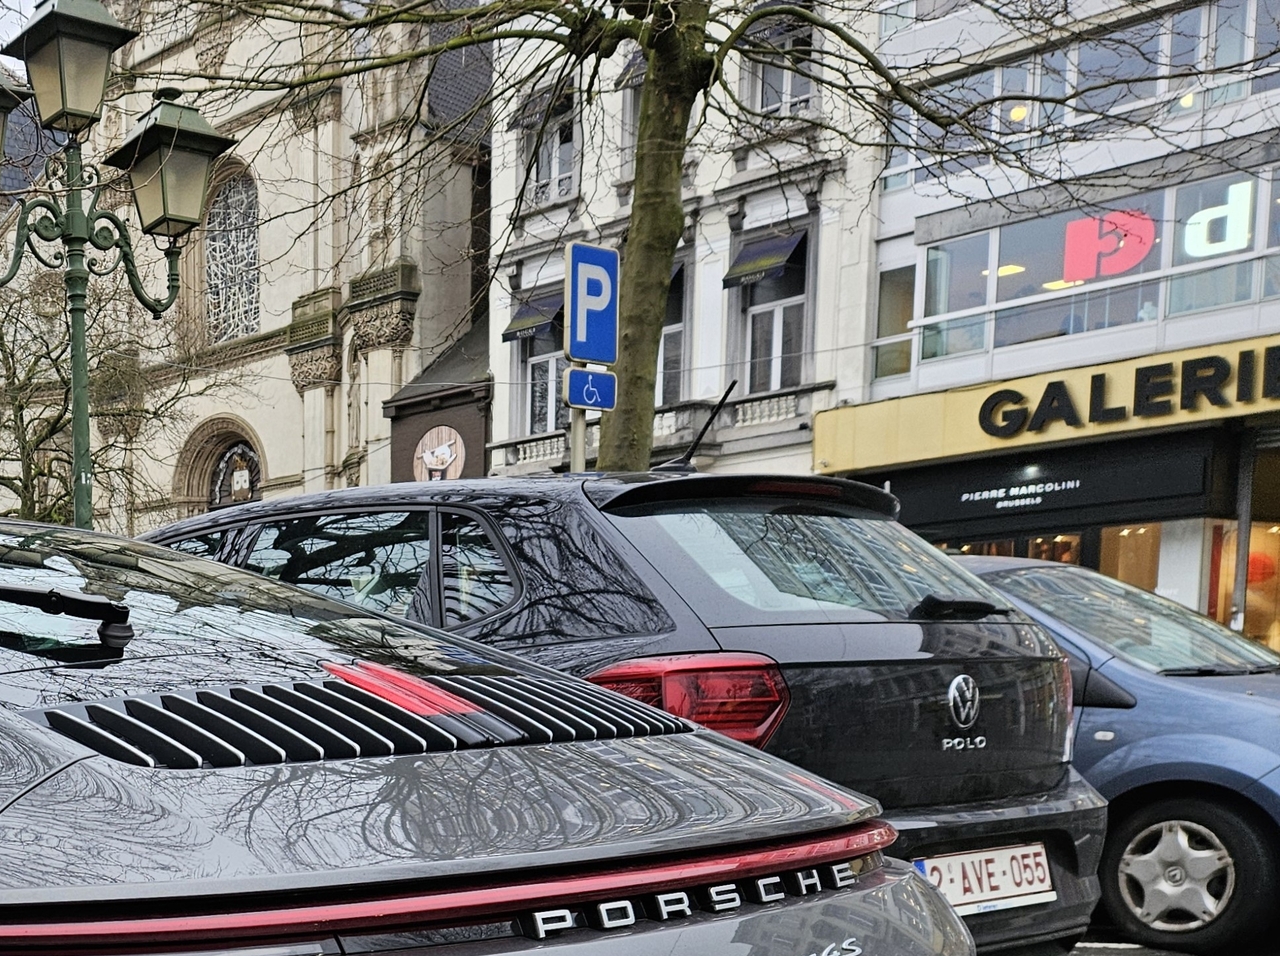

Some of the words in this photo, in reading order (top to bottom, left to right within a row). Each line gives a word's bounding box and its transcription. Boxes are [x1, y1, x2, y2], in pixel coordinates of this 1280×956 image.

[577, 262, 612, 341] P
[961, 488, 1006, 501] PIERRE
[1009, 480, 1080, 497] MARCOLINI
[942, 736, 987, 750] POLO
[532, 863, 856, 939] PORSCHE
